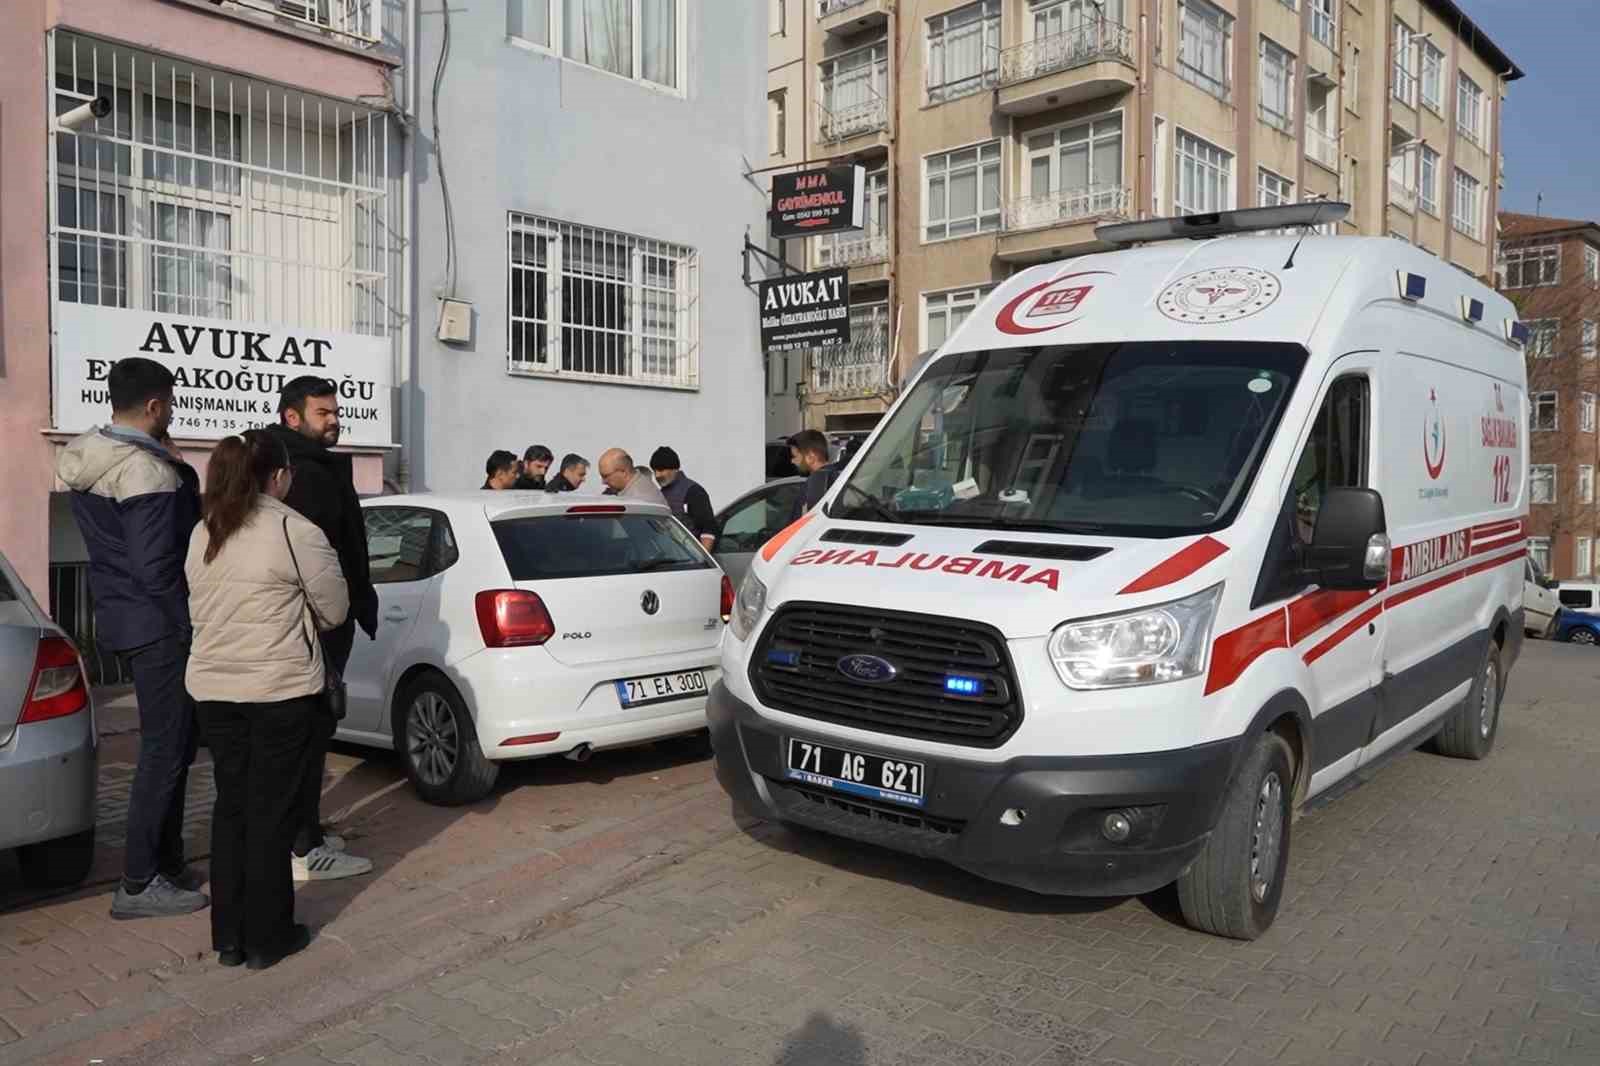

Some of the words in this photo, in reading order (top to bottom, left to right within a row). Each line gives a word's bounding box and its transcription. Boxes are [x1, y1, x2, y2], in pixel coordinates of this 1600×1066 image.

[764, 276, 842, 310] AVUKAT
[1045, 289, 1081, 304] 112
[139, 321, 332, 367] AVUKAT
[171, 395, 257, 413] ANIŞMANLIK
[262, 400, 271, 413] &
[179, 417, 201, 427] 746
[205, 418, 218, 428] 71
[223, 419, 236, 429] 35
[1493, 455, 1510, 503] 112
[1401, 531, 1466, 580] AMBULANS
[562, 631, 592, 640] POLO
[627, 682, 647, 699] 71
[654, 675, 674, 695] EA
[677, 672, 703, 691] 300
[800, 743, 822, 773] 71
[841, 752, 866, 781] AG
[881, 760, 919, 793] 621
